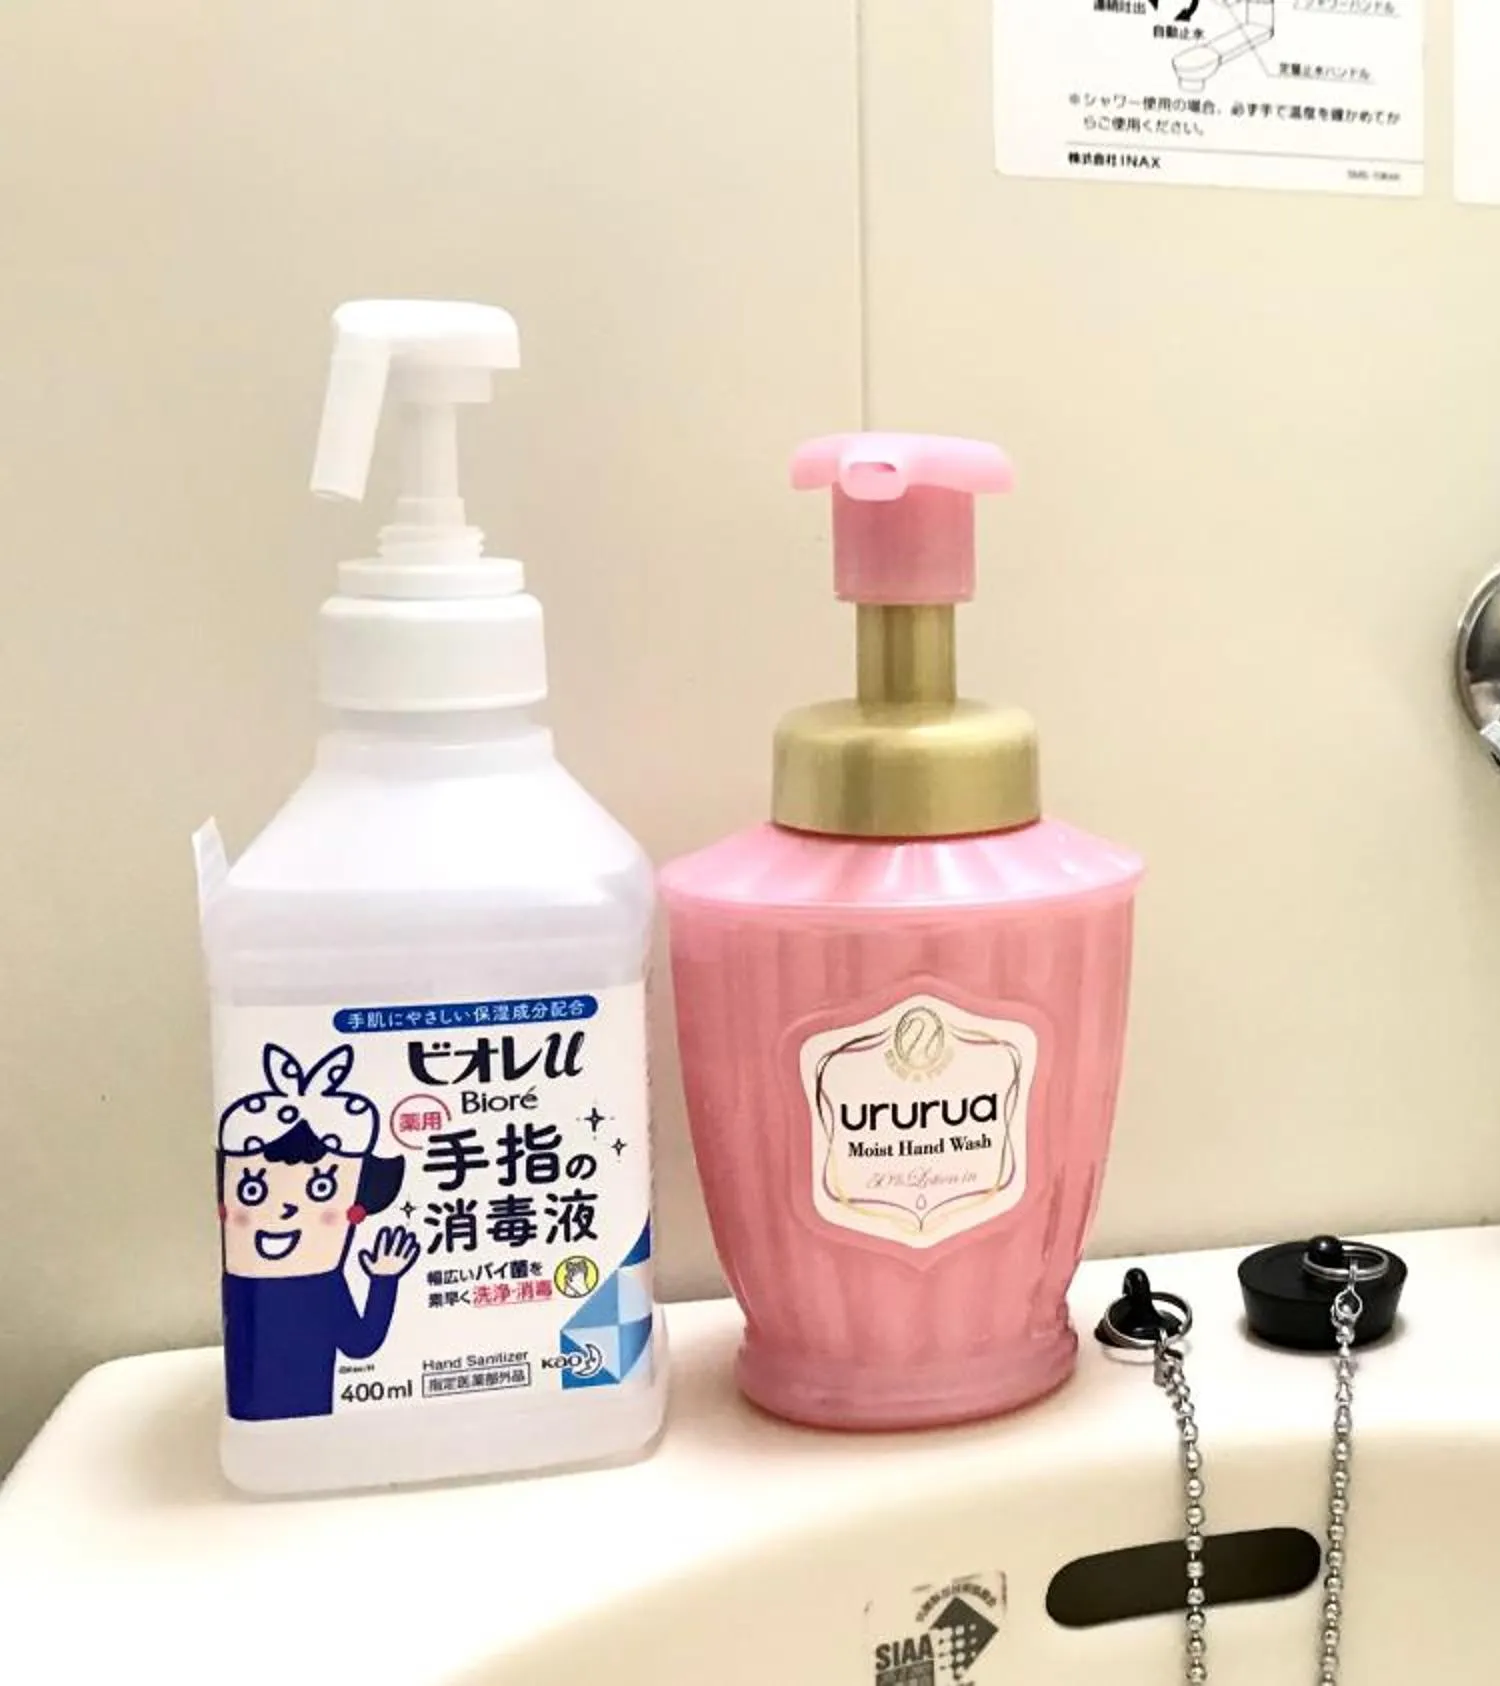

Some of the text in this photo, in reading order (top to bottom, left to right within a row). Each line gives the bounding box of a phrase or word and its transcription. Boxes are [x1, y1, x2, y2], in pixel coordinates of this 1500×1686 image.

[1153, 24, 1204, 40] 自動止水
[347, 999, 586, 1030] 手肌にやさしい保湿成分配合
[460, 1086, 540, 1115] Bioré
[841, 1092, 999, 1132] ururua
[398, 1110, 443, 1132] 薬用
[423, 1123, 598, 1191] 手指の
[848, 1133, 992, 1158] Moist Hand Wash
[426, 1188, 599, 1255] 消毒液
[427, 1259, 543, 1286] 幅広いバイ菌を
[422, 1351, 529, 1371] Hand Sanitizer
[428, 1369, 526, 1392] 指定医薬部外品
[875, 1633, 935, 1671] SIAA
